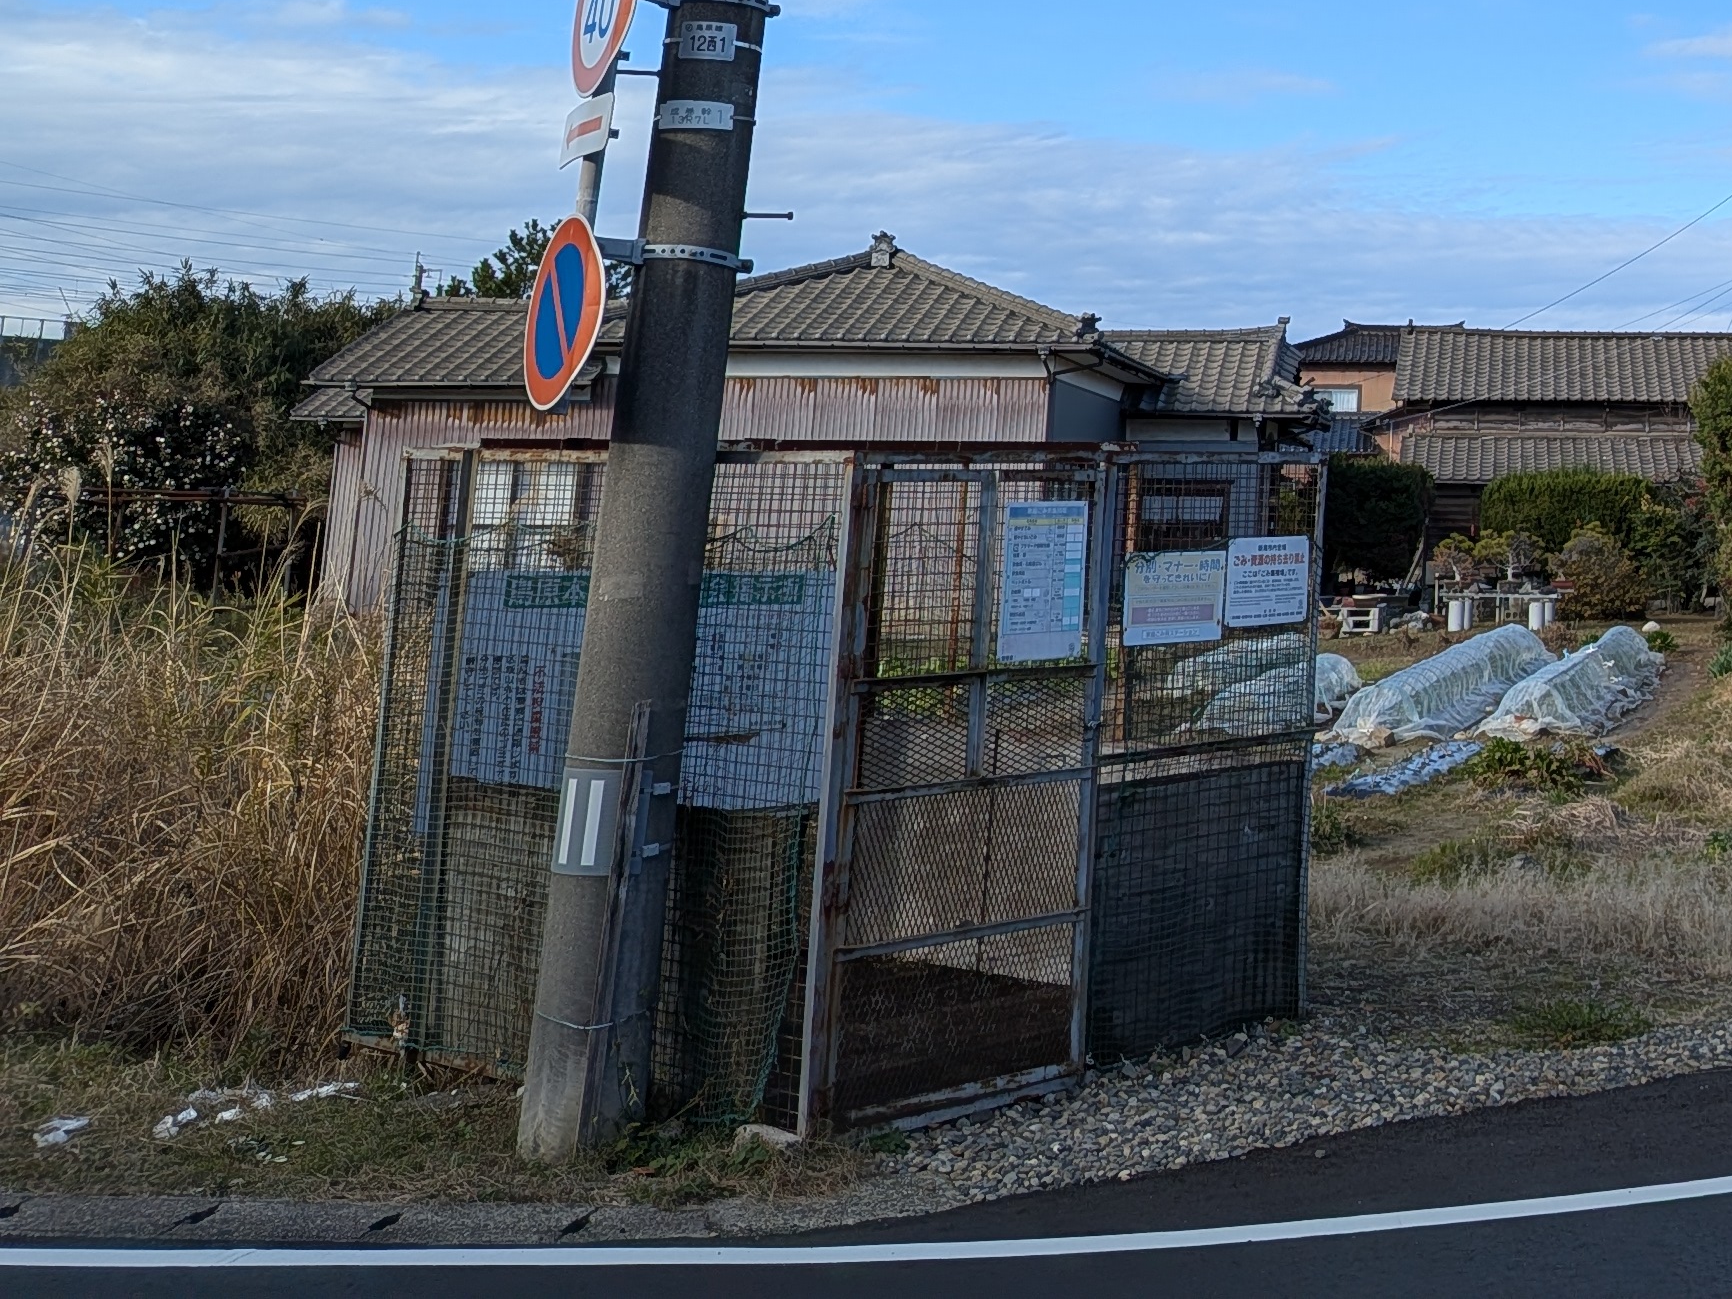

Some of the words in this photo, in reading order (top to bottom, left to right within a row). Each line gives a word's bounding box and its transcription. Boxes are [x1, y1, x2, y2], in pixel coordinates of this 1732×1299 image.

[1134, 558, 1221, 574] 分別・マナー・時間
